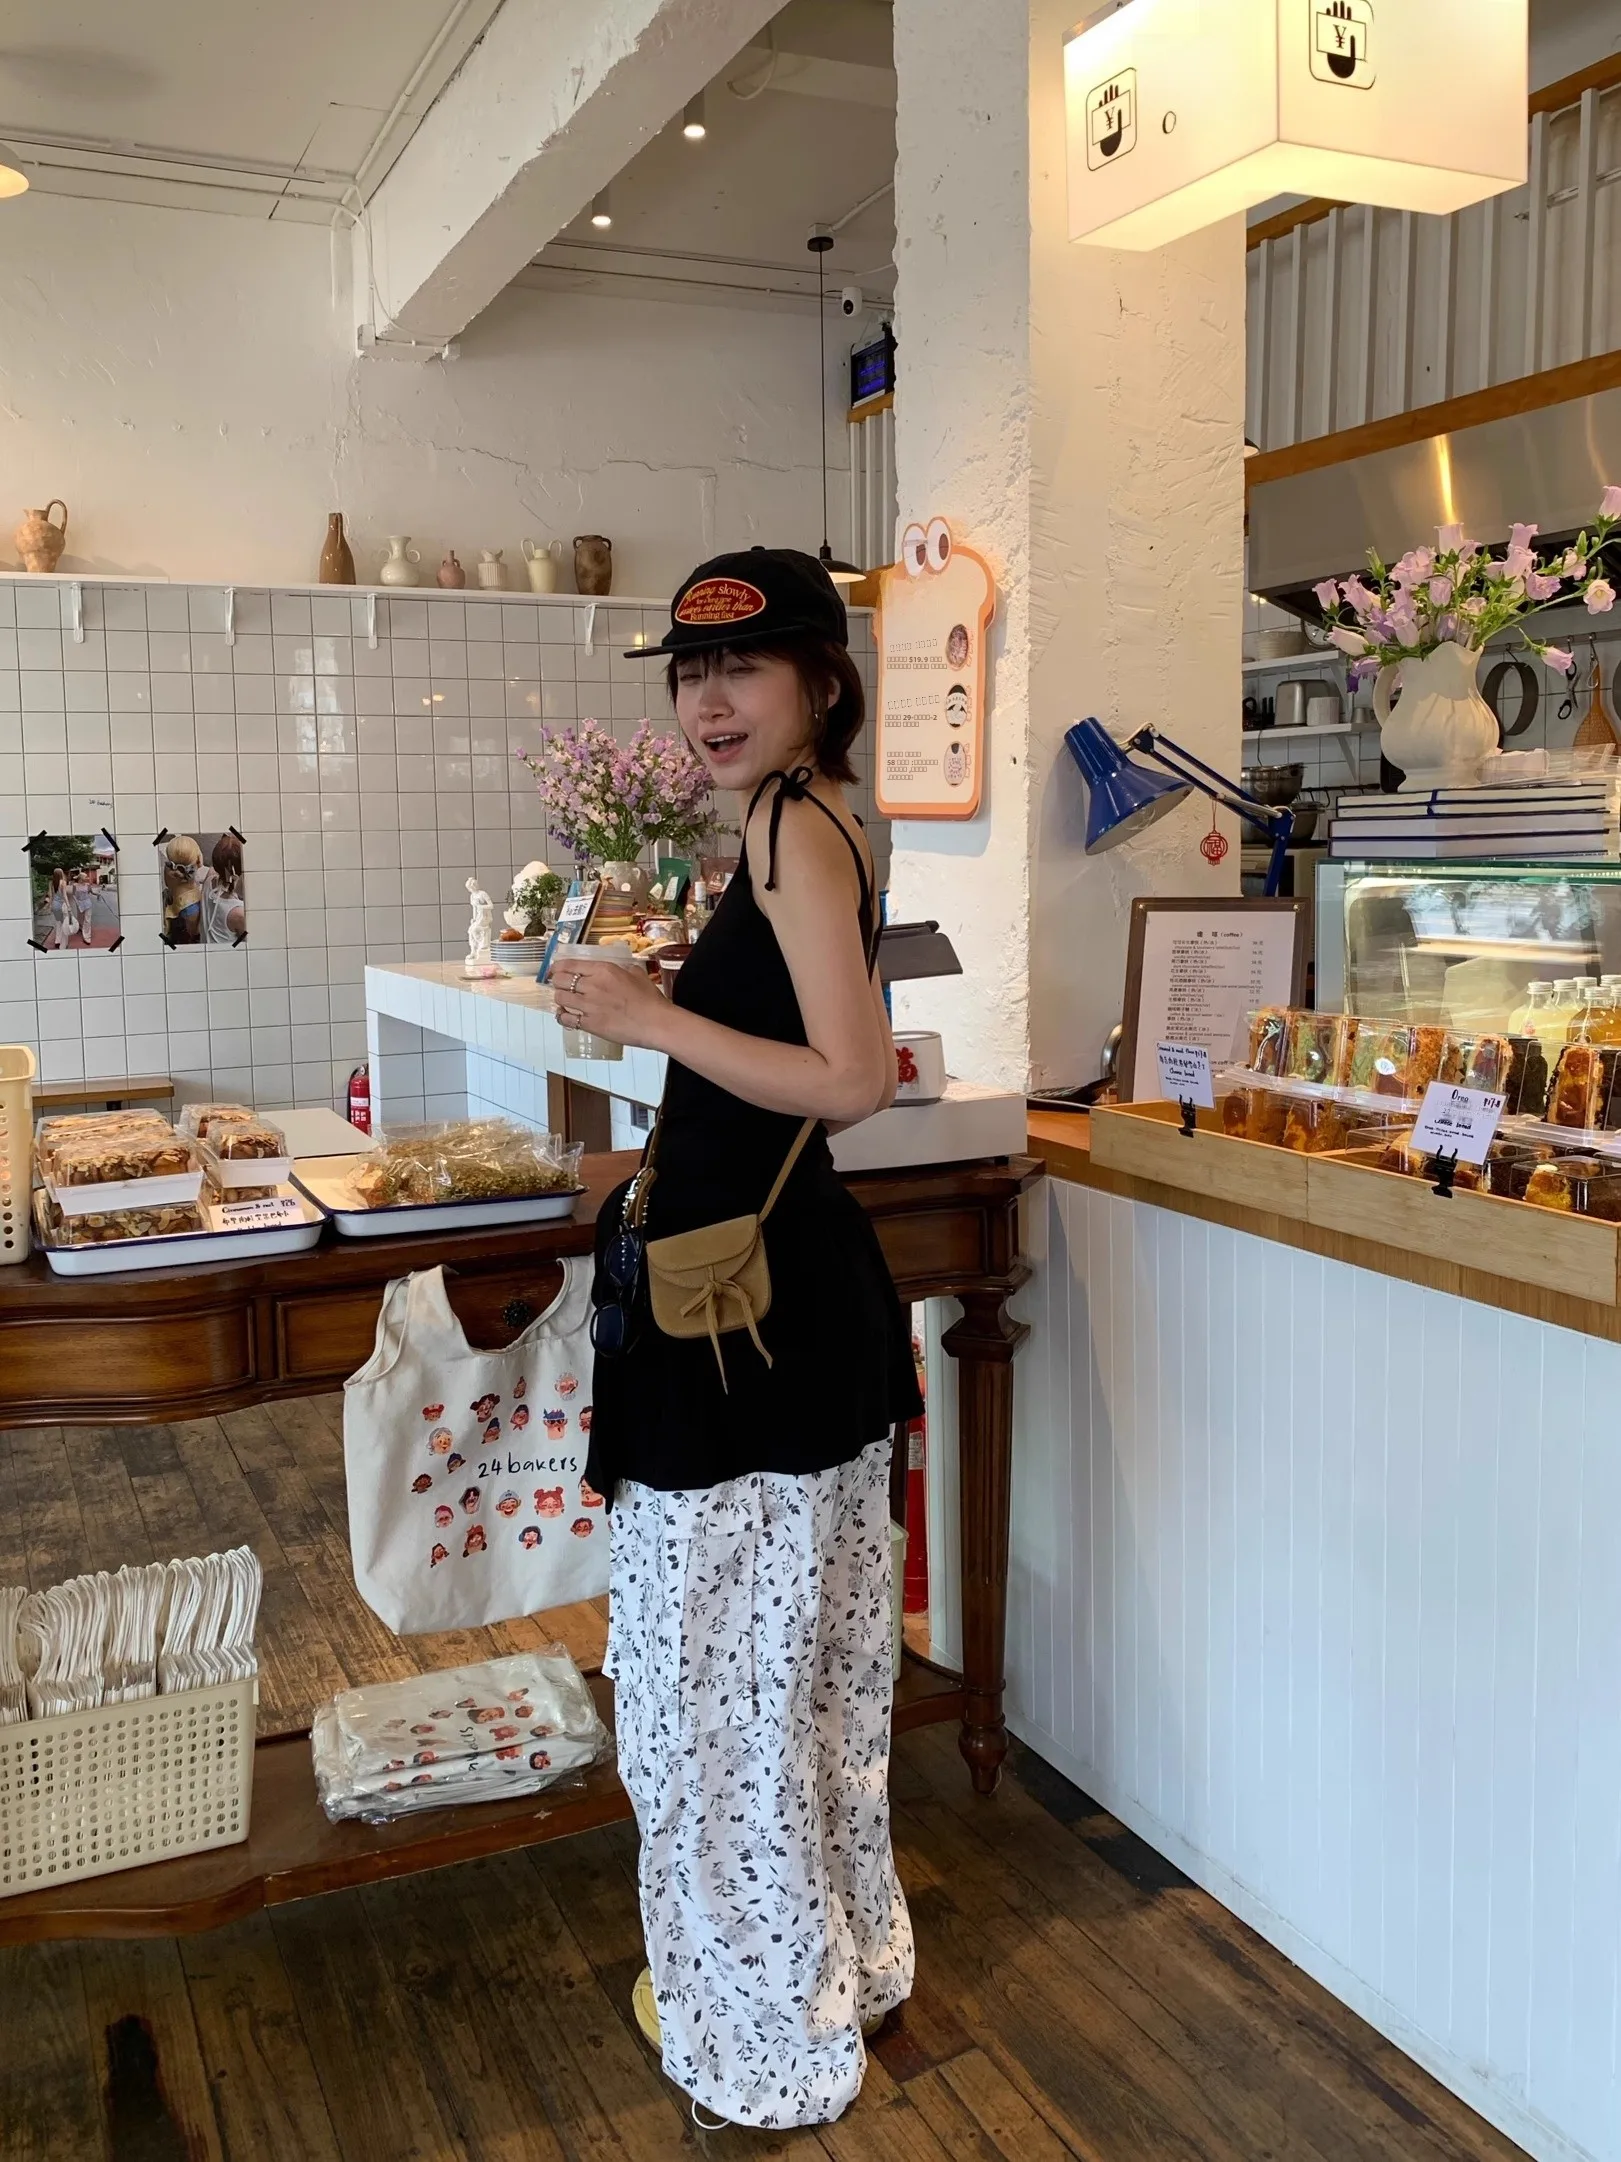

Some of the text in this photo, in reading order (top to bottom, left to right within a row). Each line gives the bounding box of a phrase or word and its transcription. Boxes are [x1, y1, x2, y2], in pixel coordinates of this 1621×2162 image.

[718, 583, 751, 604] slowly
[732, 602, 754, 612] than
[690, 612, 720, 621] Running
[1452, 1089, 1469, 1102] Oreo
[508, 1451, 577, 1473] bakers
